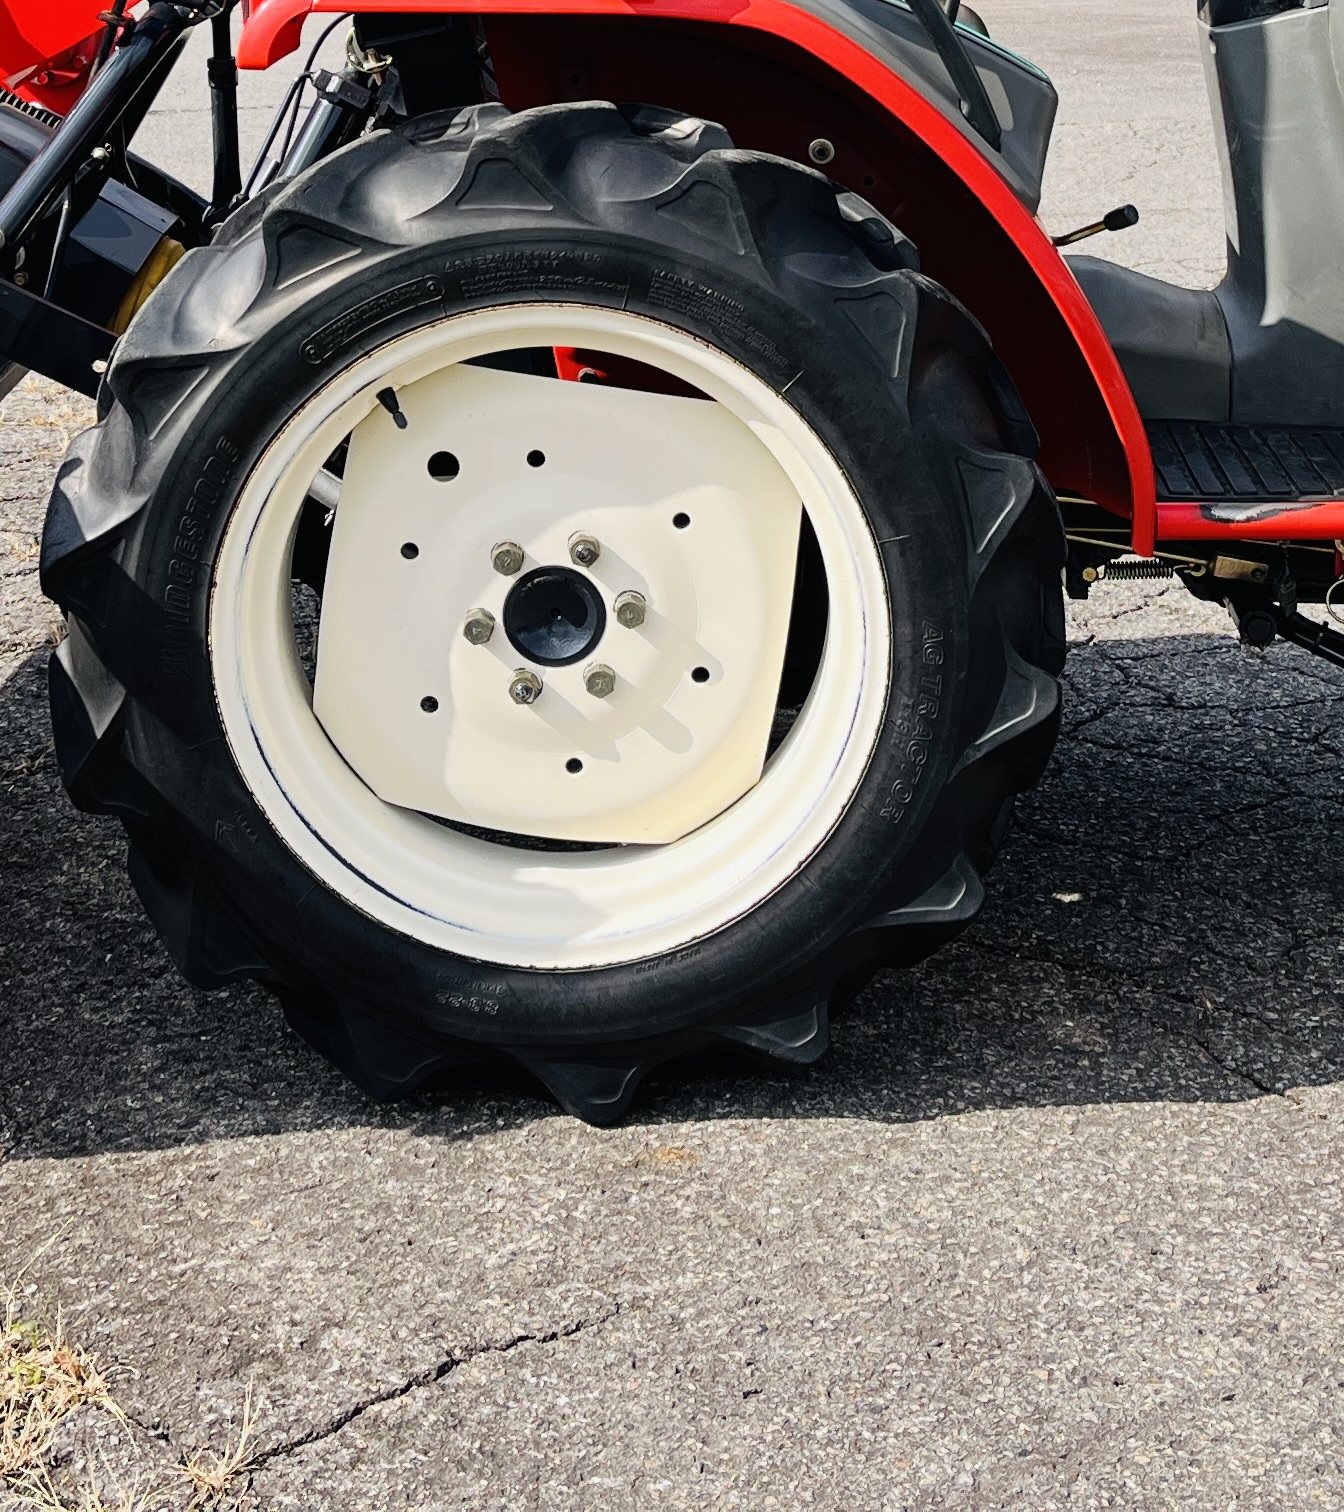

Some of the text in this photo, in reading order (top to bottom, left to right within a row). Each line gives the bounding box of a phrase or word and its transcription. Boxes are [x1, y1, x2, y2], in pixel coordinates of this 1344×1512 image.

[160, 434, 242, 676] BRIDGESTONE
[921, 619, 945, 665] AG
[879, 674, 943, 825] TRACTOR
